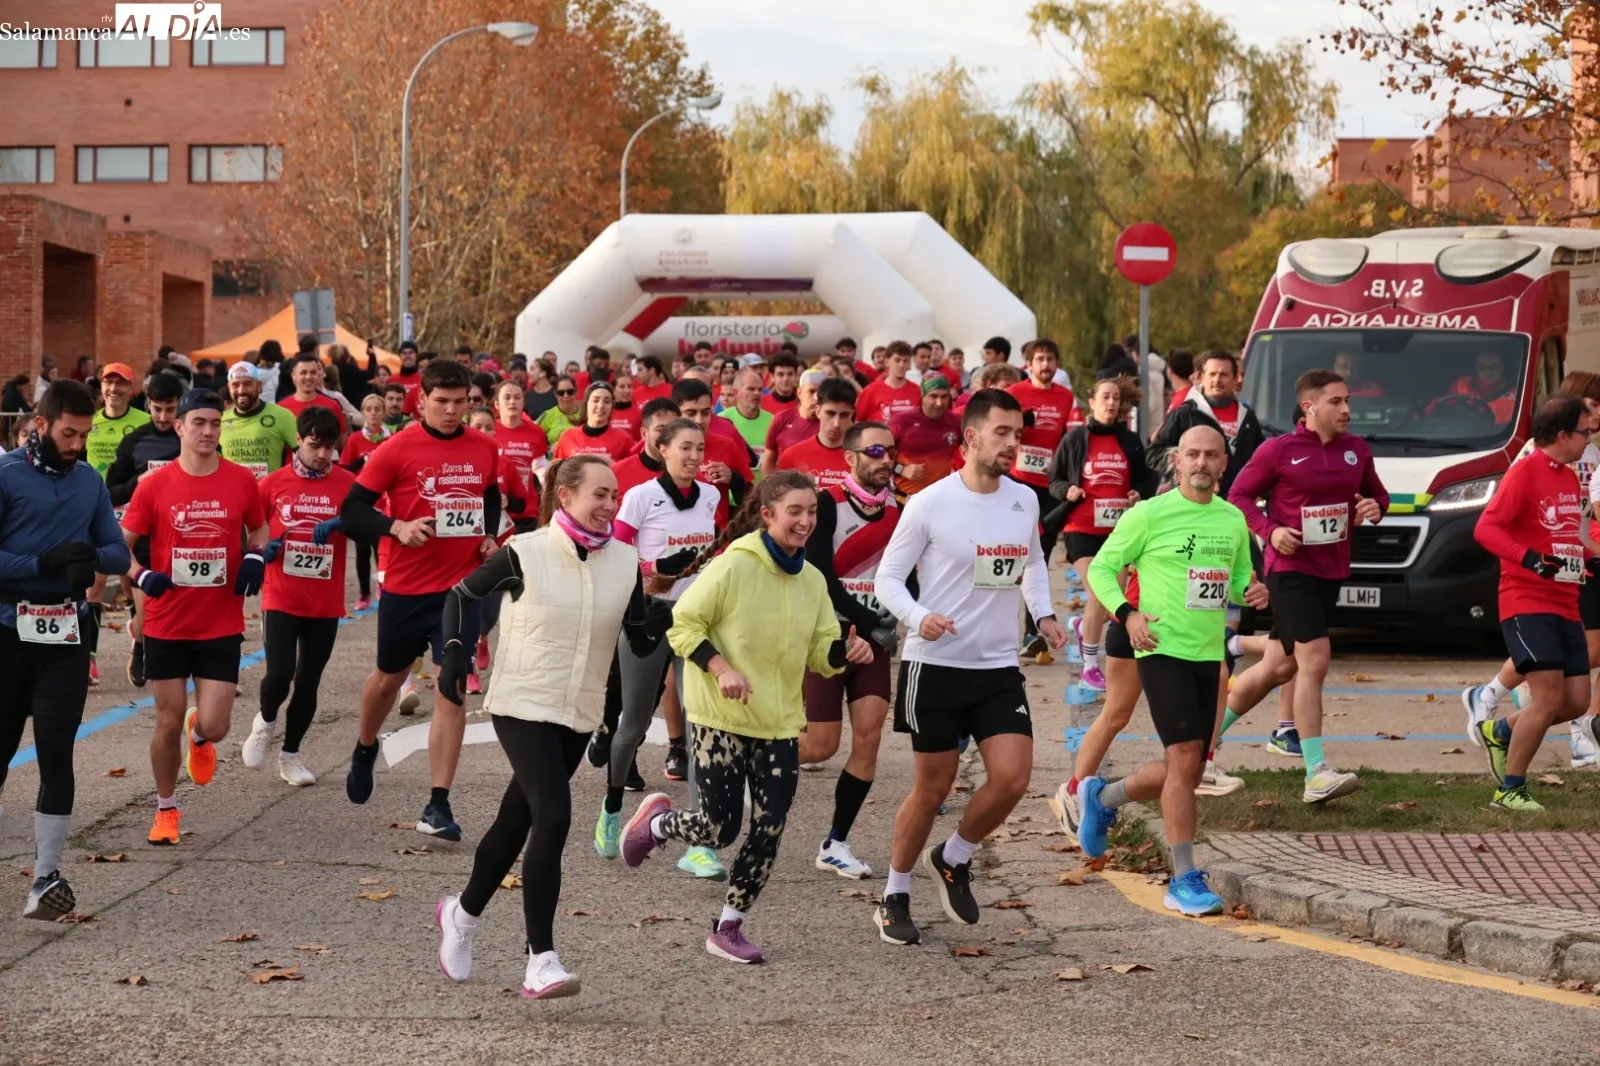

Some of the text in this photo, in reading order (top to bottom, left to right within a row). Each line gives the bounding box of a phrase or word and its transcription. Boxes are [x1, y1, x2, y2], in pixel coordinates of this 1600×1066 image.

[463, 463, 474, 473] sin
[1024, 455, 1045, 467] 325
[319, 494, 330, 505] sin
[437, 500, 482, 511] bedunia
[446, 511, 475, 528] 264
[1303, 506, 1348, 519] bedunia
[1320, 518, 1337, 534] 12
[668, 534, 714, 546] bedunia
[173, 549, 225, 561] bedunia
[287, 542, 333, 556] bedunia
[976, 544, 1028, 557] bedunia
[294, 554, 323, 570] 227
[993, 558, 1015, 577] 87
[189, 562, 210, 577] 98
[1199, 583, 1224, 599] 220
[1346, 588, 1377, 605] LMH
[35, 617, 60, 635] 86
